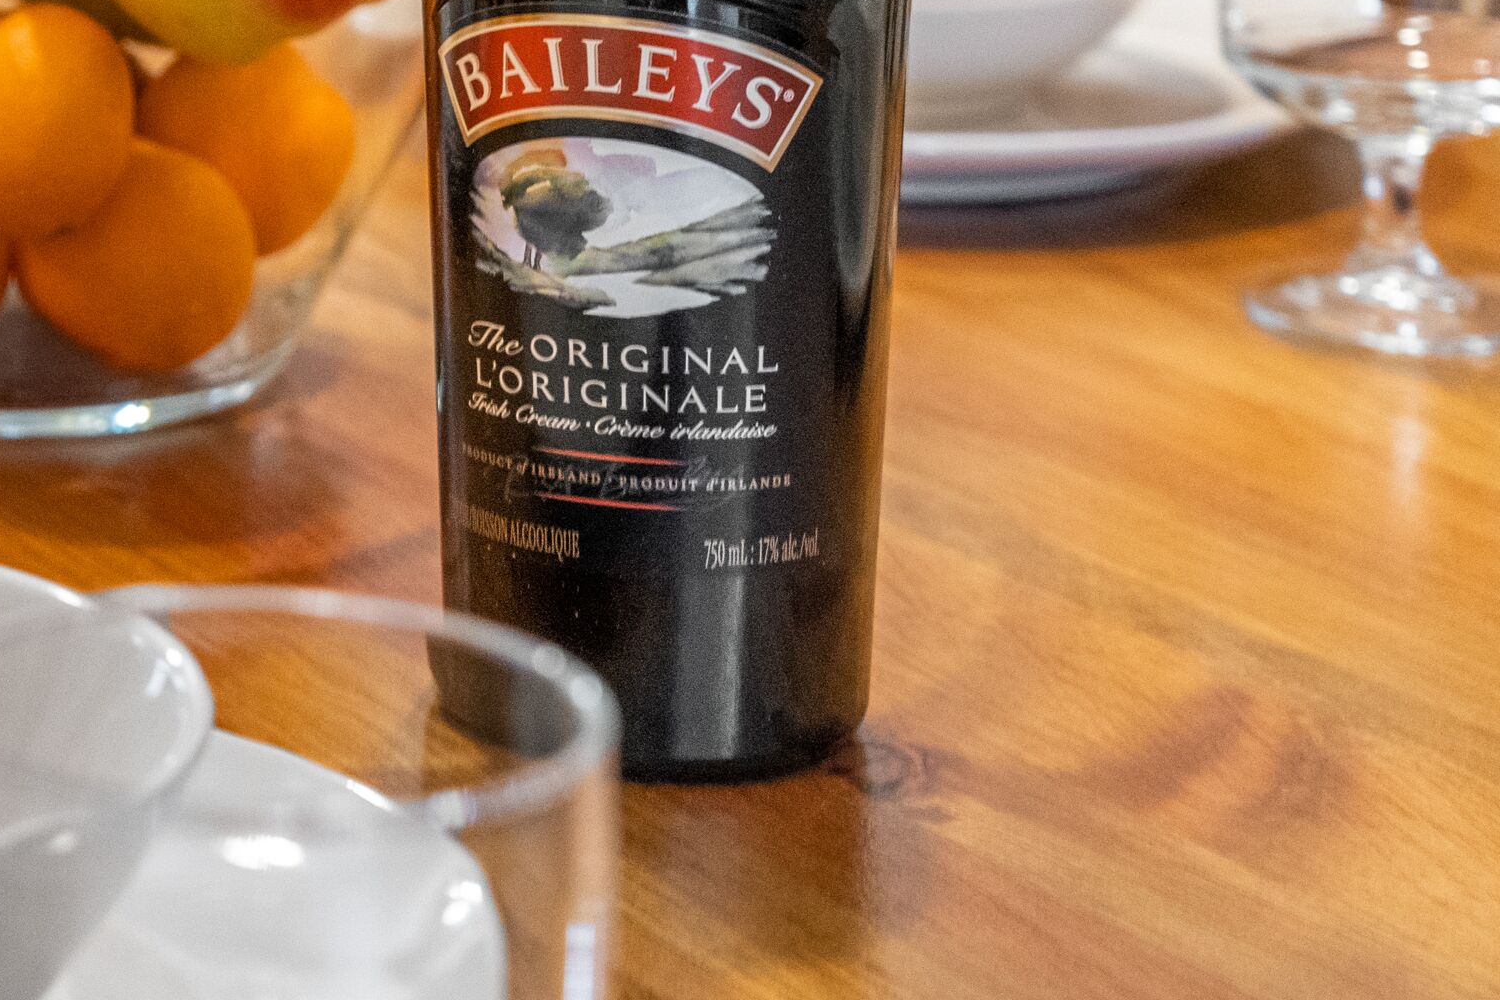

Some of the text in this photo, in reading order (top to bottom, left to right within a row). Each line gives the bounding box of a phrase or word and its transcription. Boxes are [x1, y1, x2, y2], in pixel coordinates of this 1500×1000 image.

[468, 320, 779, 375] The ORIGINAL
[475, 357, 768, 414] L'ORIGINALE
[468, 391, 778, 442] Irish Cream Crème irlandaise
[531, 463, 601, 486] IRELAND
[619, 475, 698, 492] PRODUIT
[510, 519, 581, 562] ALCOOLIQUE
[704, 538, 726, 570] 750
[728, 538, 748, 566] mL
[759, 535, 779, 565] 17%
